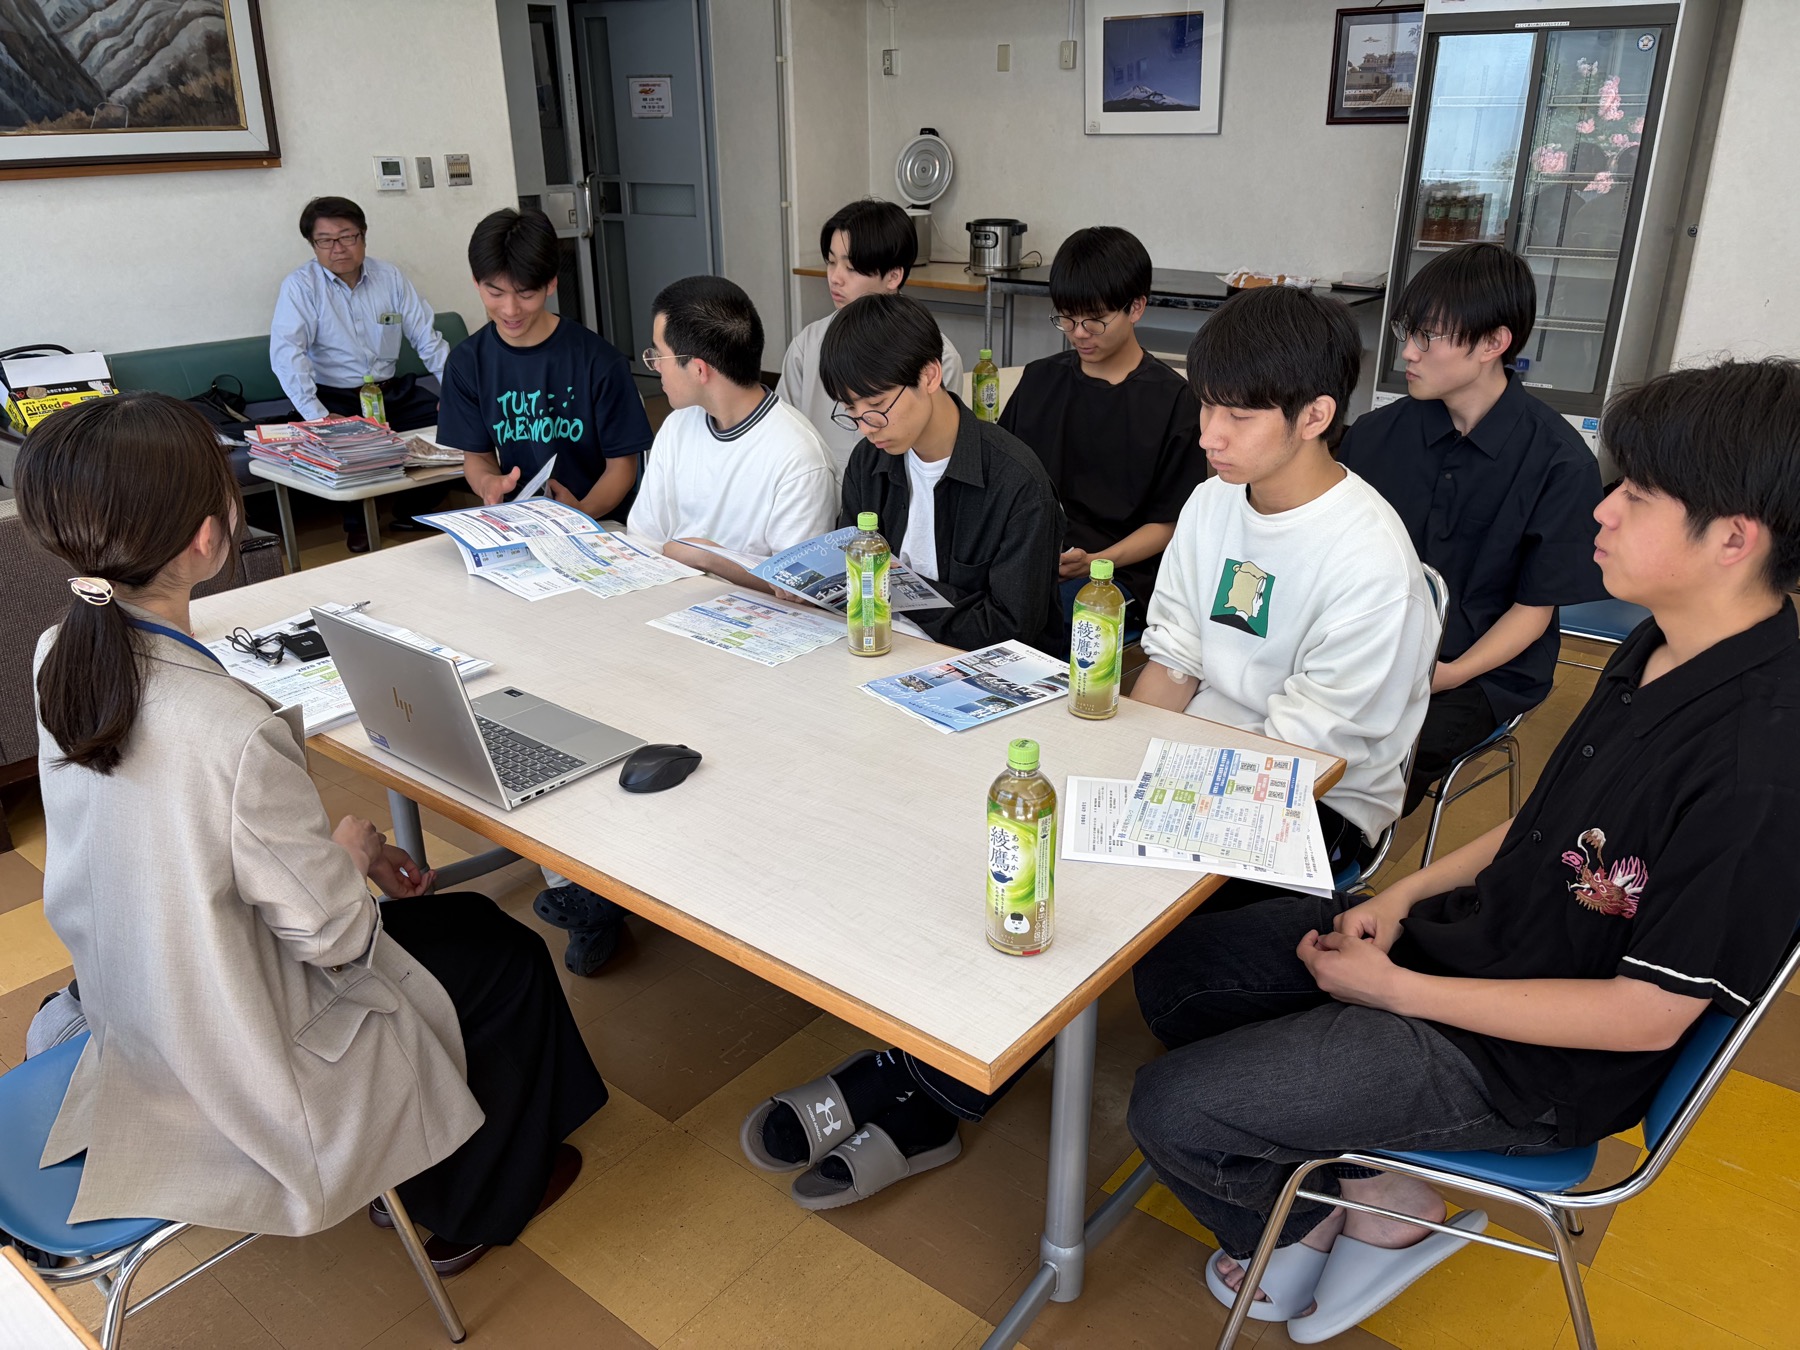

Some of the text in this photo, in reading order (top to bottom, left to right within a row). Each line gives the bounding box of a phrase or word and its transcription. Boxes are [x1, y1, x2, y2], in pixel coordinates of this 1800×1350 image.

[25, 401, 61, 414] AirBed
[1077, 620, 1094, 658] 綾鷹
[392, 686, 413, 723] hp
[990, 826, 1011, 871] 綾鷹
[1011, 834, 1019, 871] あやたか
